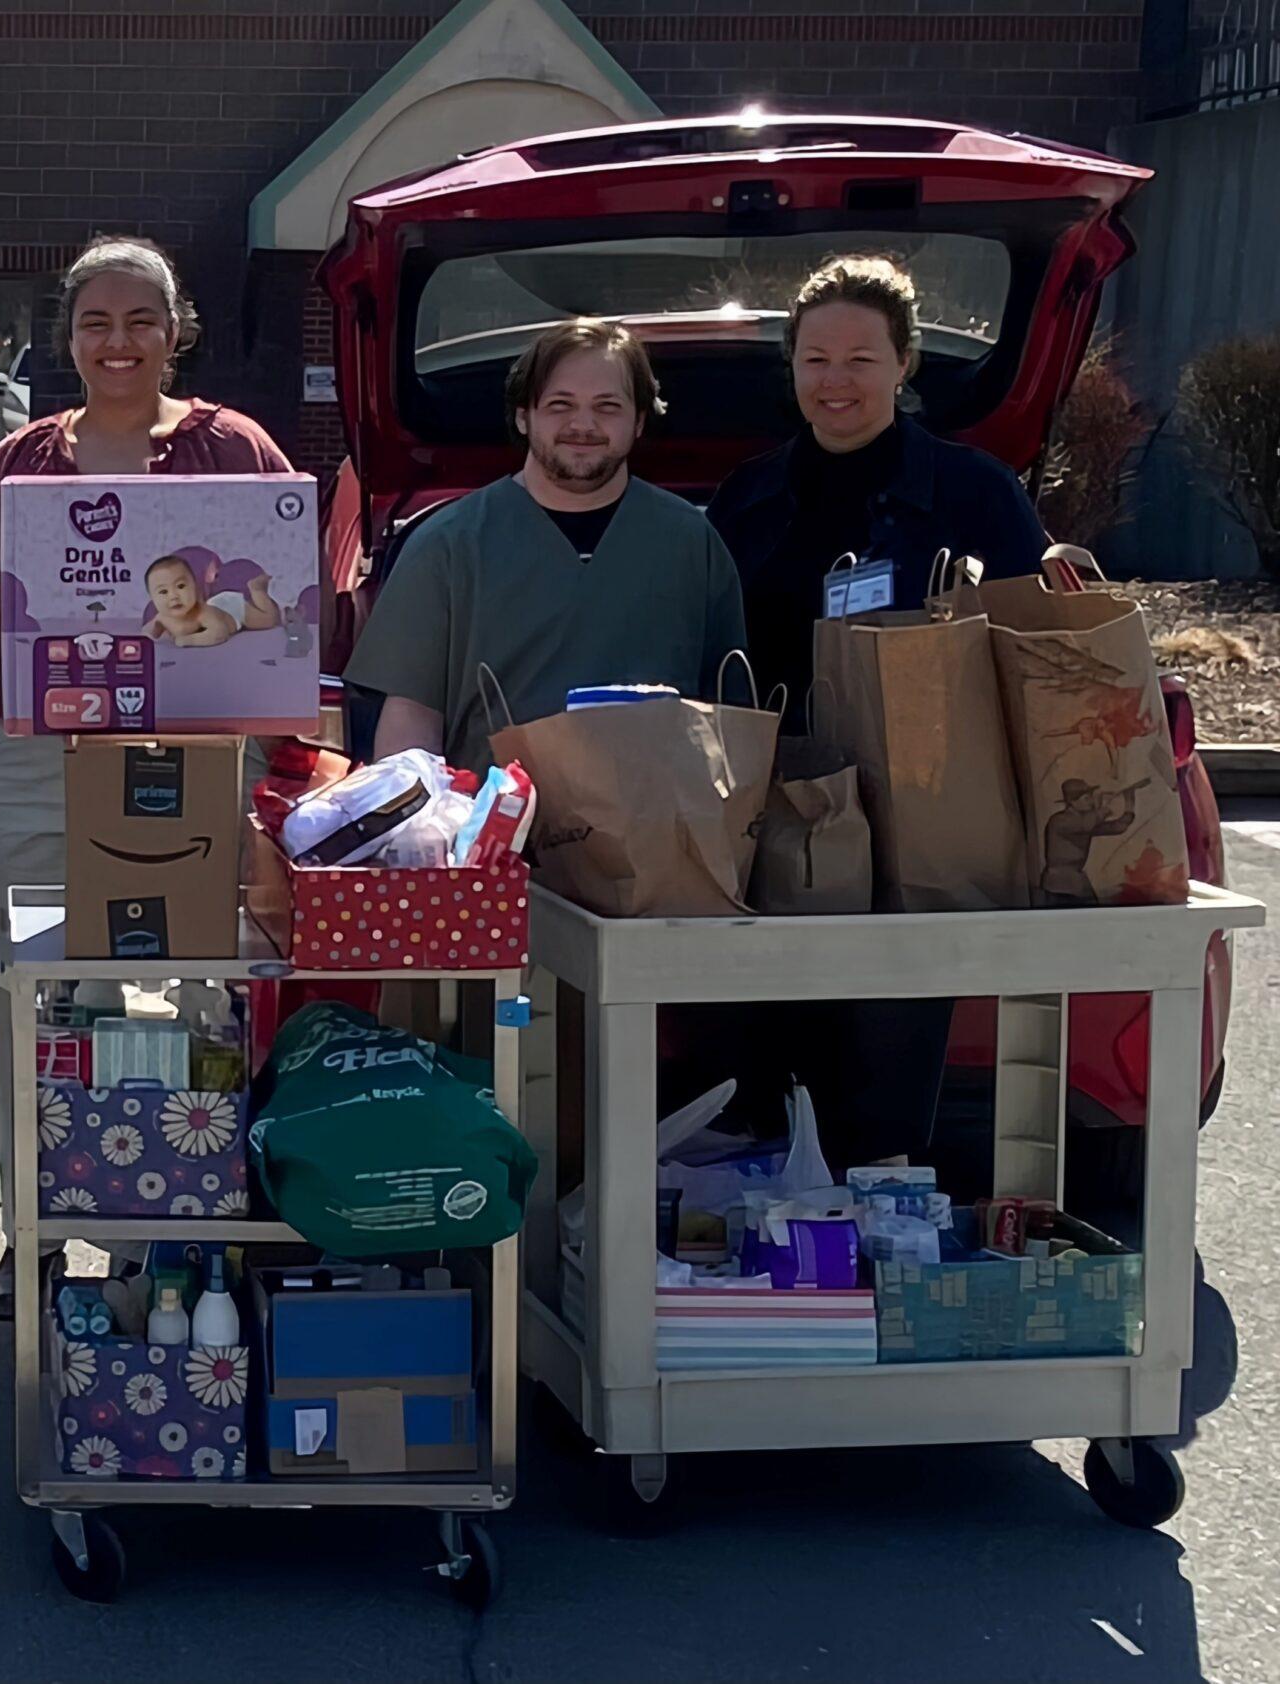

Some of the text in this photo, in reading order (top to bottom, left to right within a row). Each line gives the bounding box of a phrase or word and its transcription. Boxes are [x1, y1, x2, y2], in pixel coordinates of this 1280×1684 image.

[65, 547, 126, 567] Dry &
[59, 565, 132, 583] Gentle
[80, 693, 102, 723] 2
